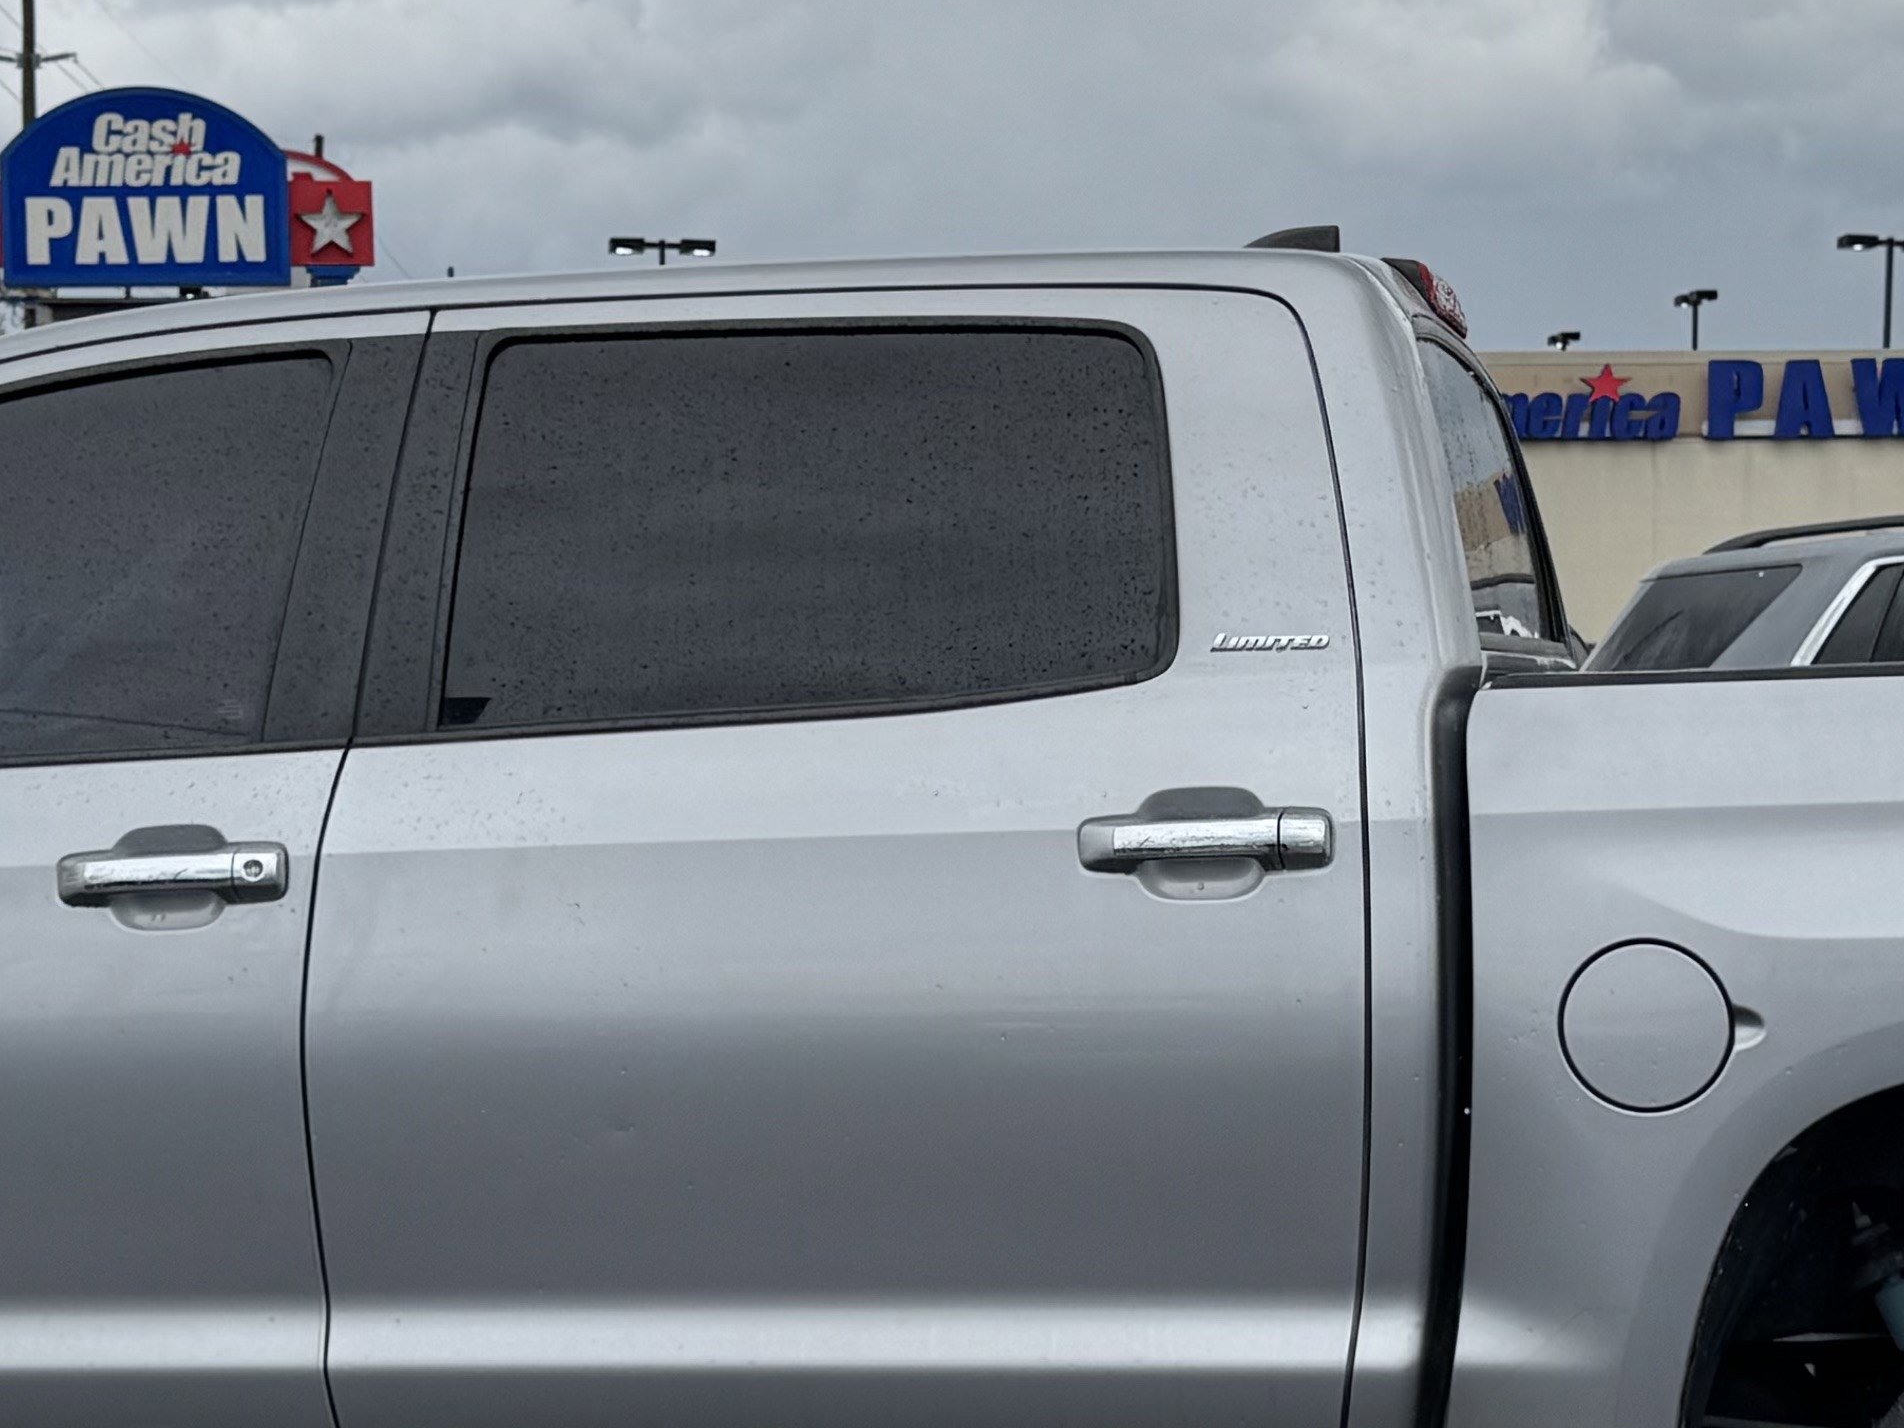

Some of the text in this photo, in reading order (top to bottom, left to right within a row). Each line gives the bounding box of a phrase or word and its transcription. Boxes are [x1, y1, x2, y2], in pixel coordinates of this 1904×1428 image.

[92, 112, 206, 154] Cash
[50, 146, 241, 187] America
[24, 194, 267, 266] PAWN
[1501, 392, 1681, 439] erica
[1210, 633, 1330, 652] LIMITED
